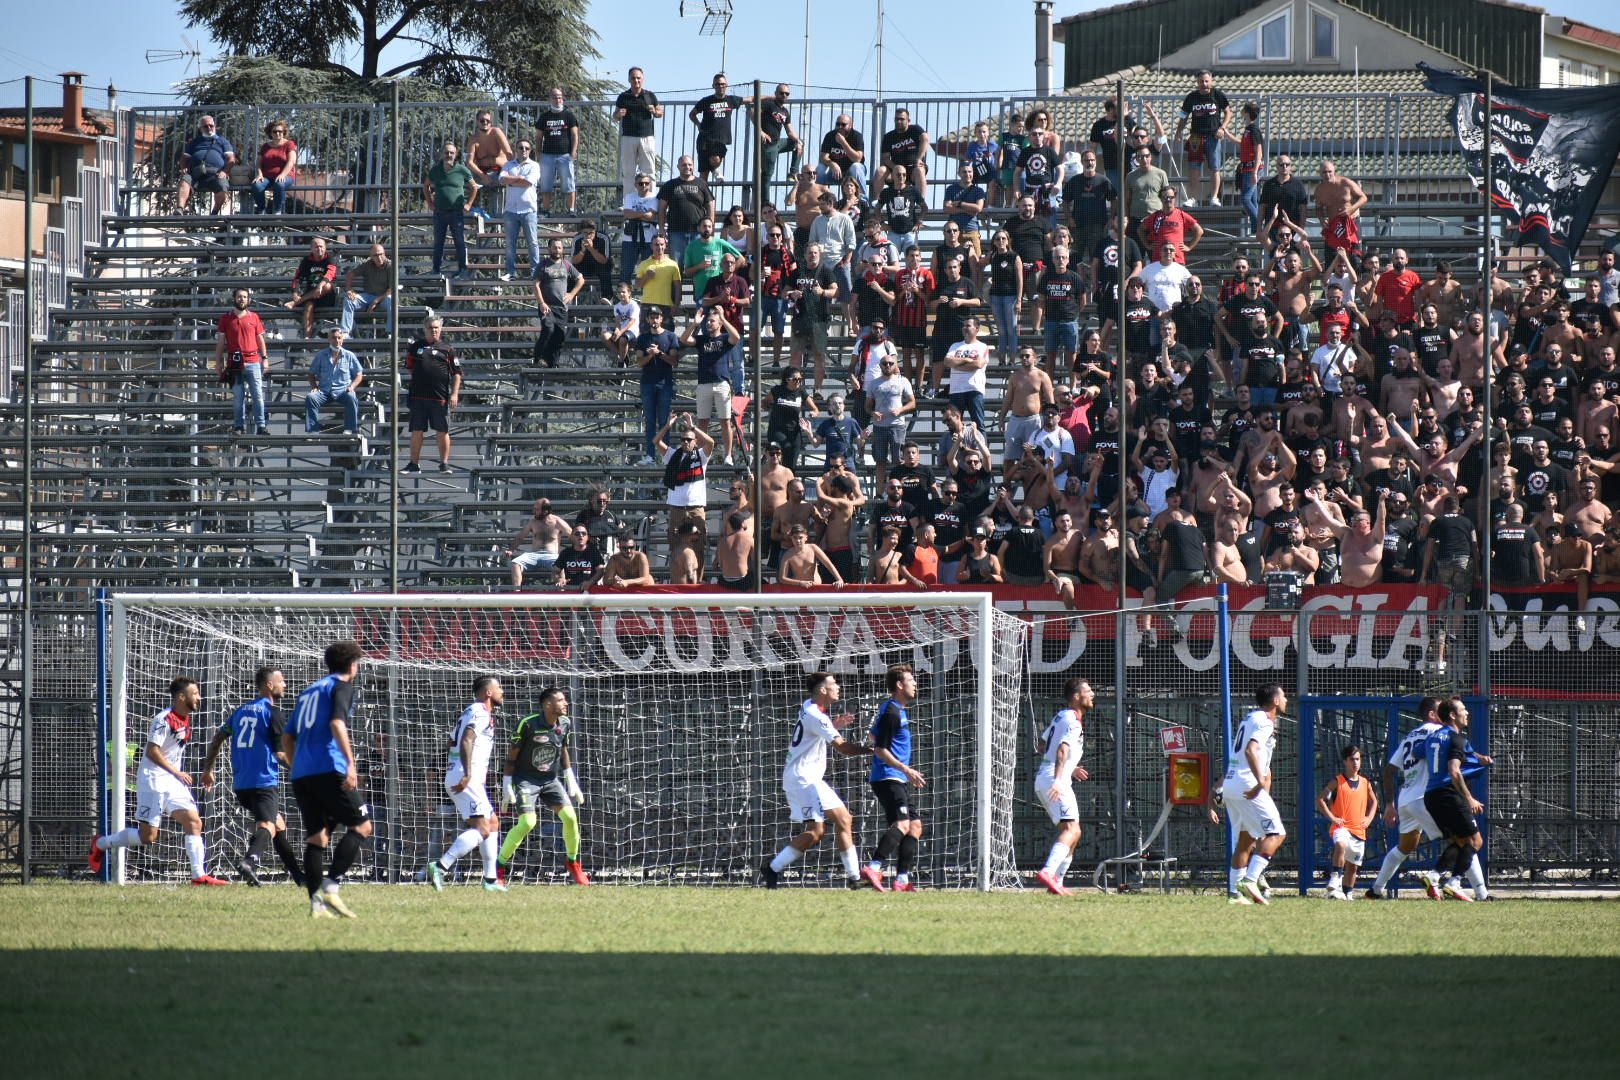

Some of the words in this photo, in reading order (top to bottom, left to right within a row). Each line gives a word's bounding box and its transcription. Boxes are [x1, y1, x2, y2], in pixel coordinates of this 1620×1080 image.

[601, 606, 888, 674] CURVA
[237, 716, 258, 748] 27
[296, 690, 320, 734] 70
